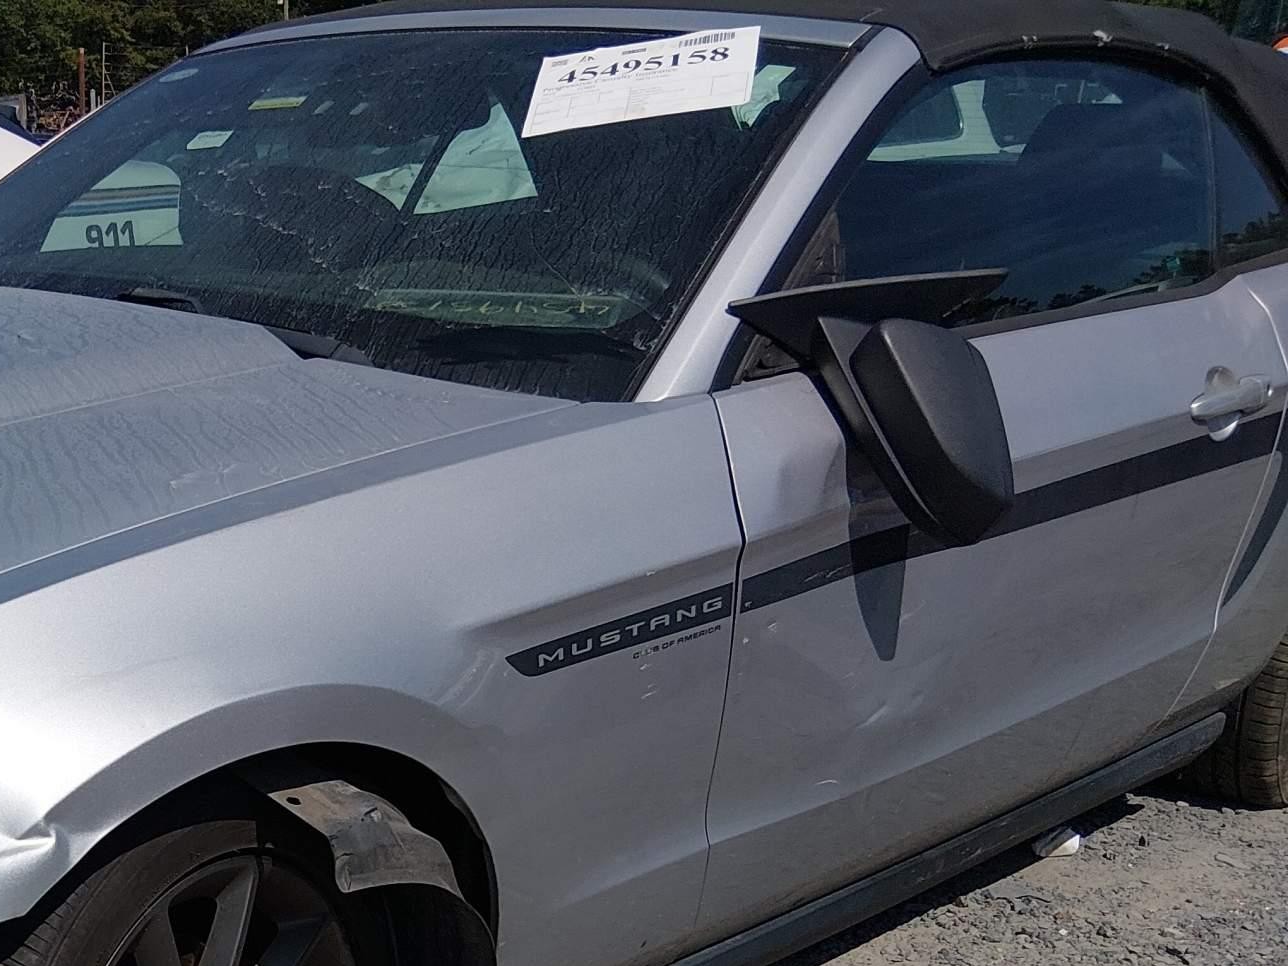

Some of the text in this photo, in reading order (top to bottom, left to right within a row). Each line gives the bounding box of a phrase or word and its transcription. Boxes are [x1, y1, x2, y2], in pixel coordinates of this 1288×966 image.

[558, 46, 730, 84] 45495158
[85, 220, 136, 248] 911
[538, 596, 723, 668] MUSTANG
[661, 639, 676, 650] OF
[677, 624, 722, 645] AMERICA
